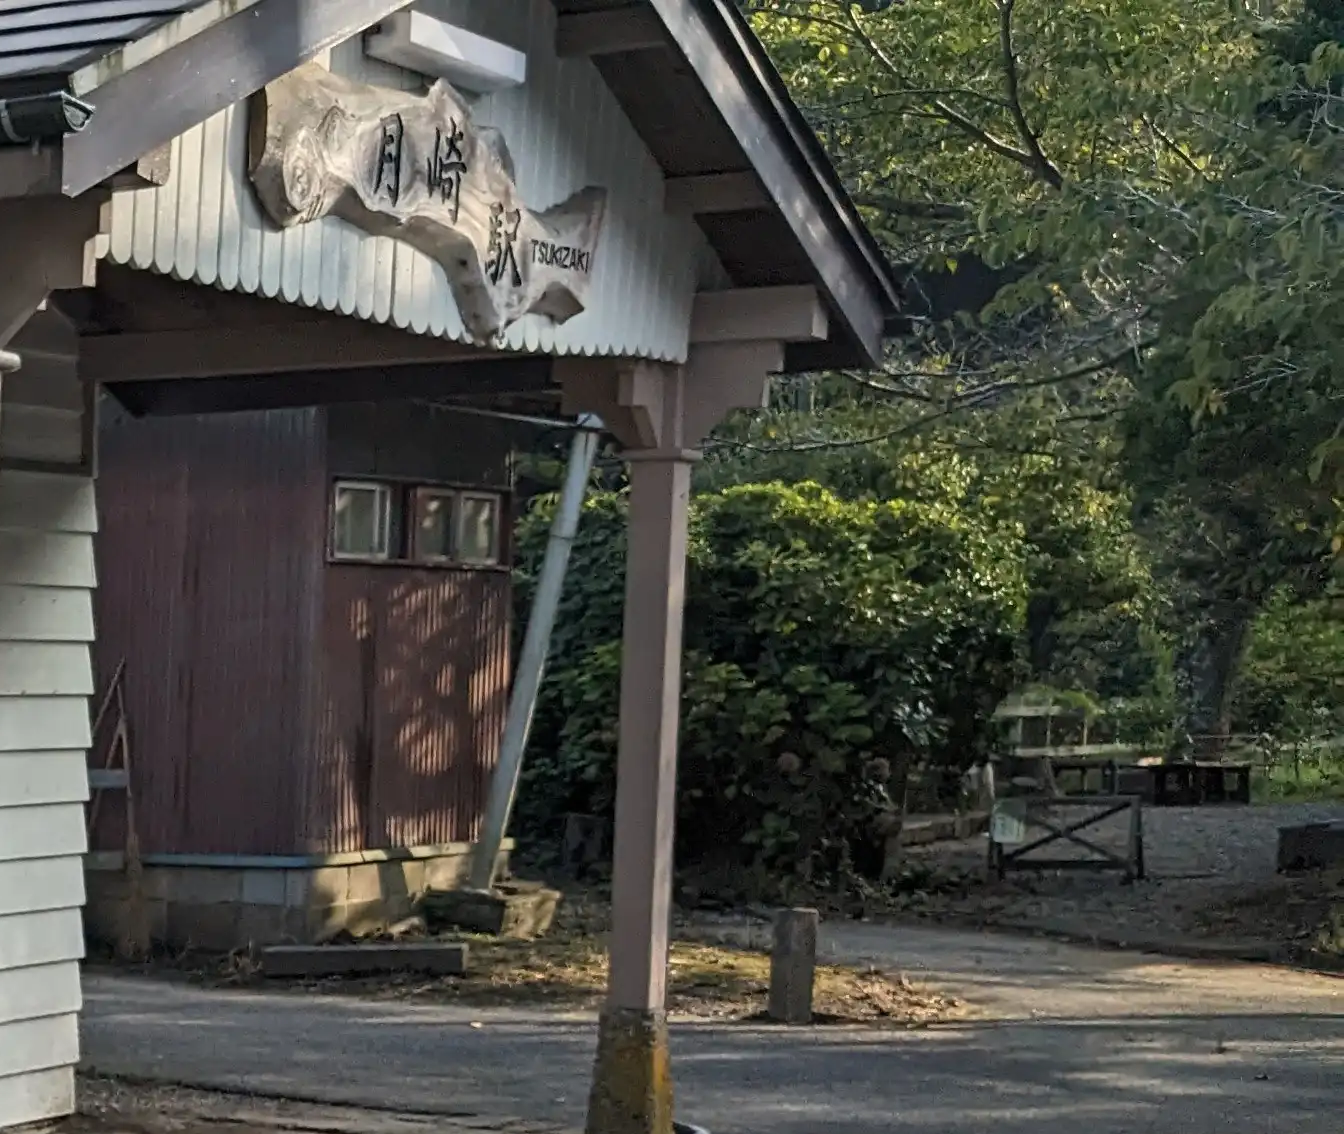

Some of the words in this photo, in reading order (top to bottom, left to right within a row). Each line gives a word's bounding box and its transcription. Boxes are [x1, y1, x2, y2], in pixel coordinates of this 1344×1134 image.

[373, 112, 523, 288] 月崎駅
[530, 238, 590, 275] TSUKIZAKI
